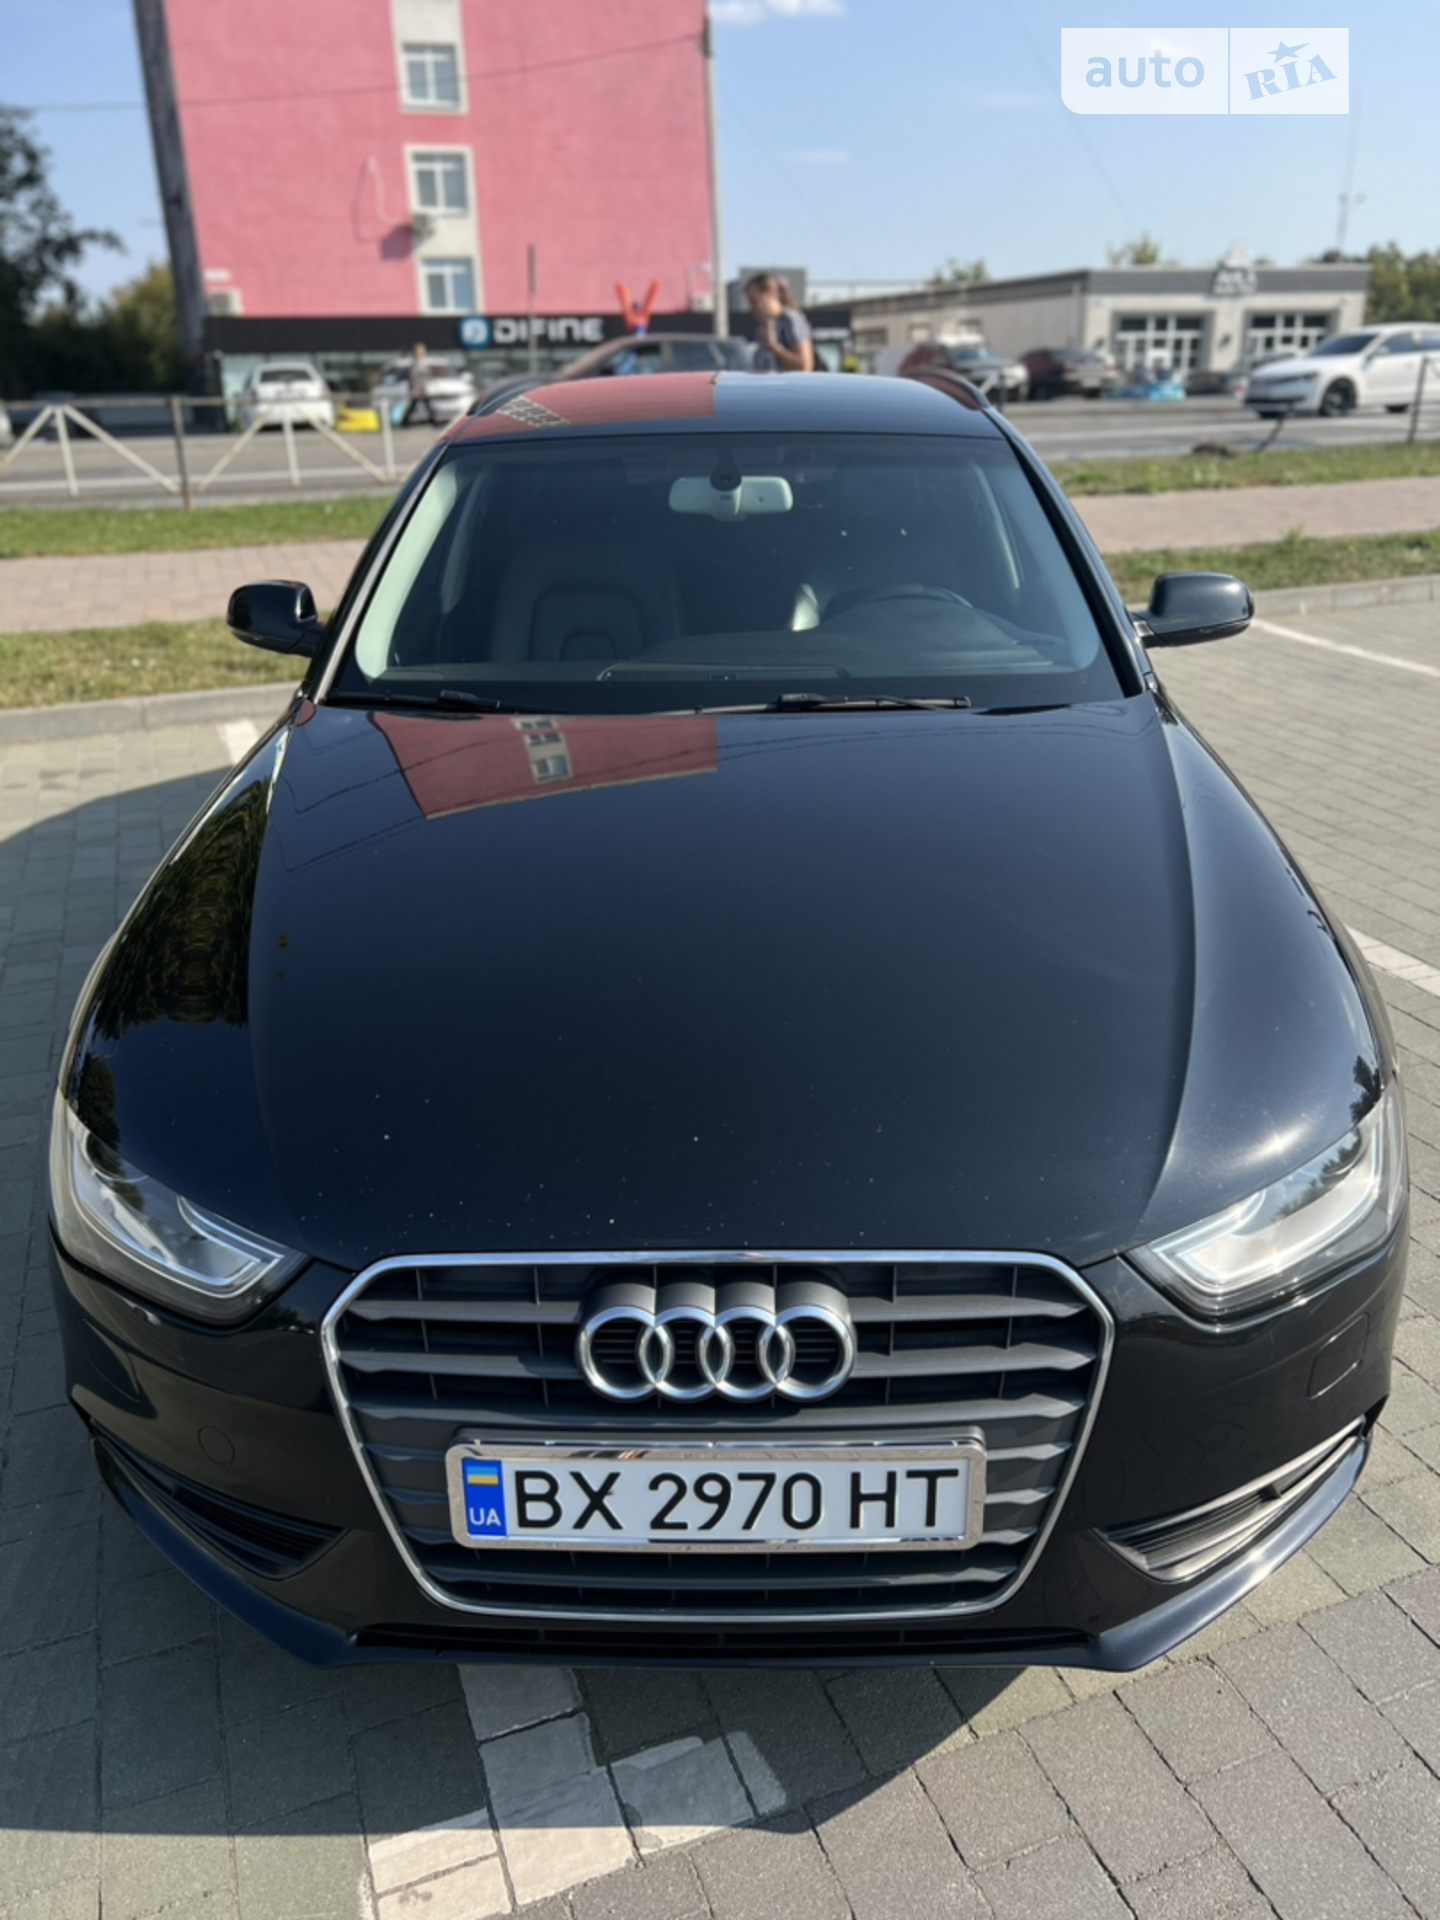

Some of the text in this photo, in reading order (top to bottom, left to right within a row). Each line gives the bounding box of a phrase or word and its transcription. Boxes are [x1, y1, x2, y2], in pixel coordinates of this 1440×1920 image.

[469, 1507, 501, 1527] UA
[514, 1468, 959, 1530] BX 2970 HT
